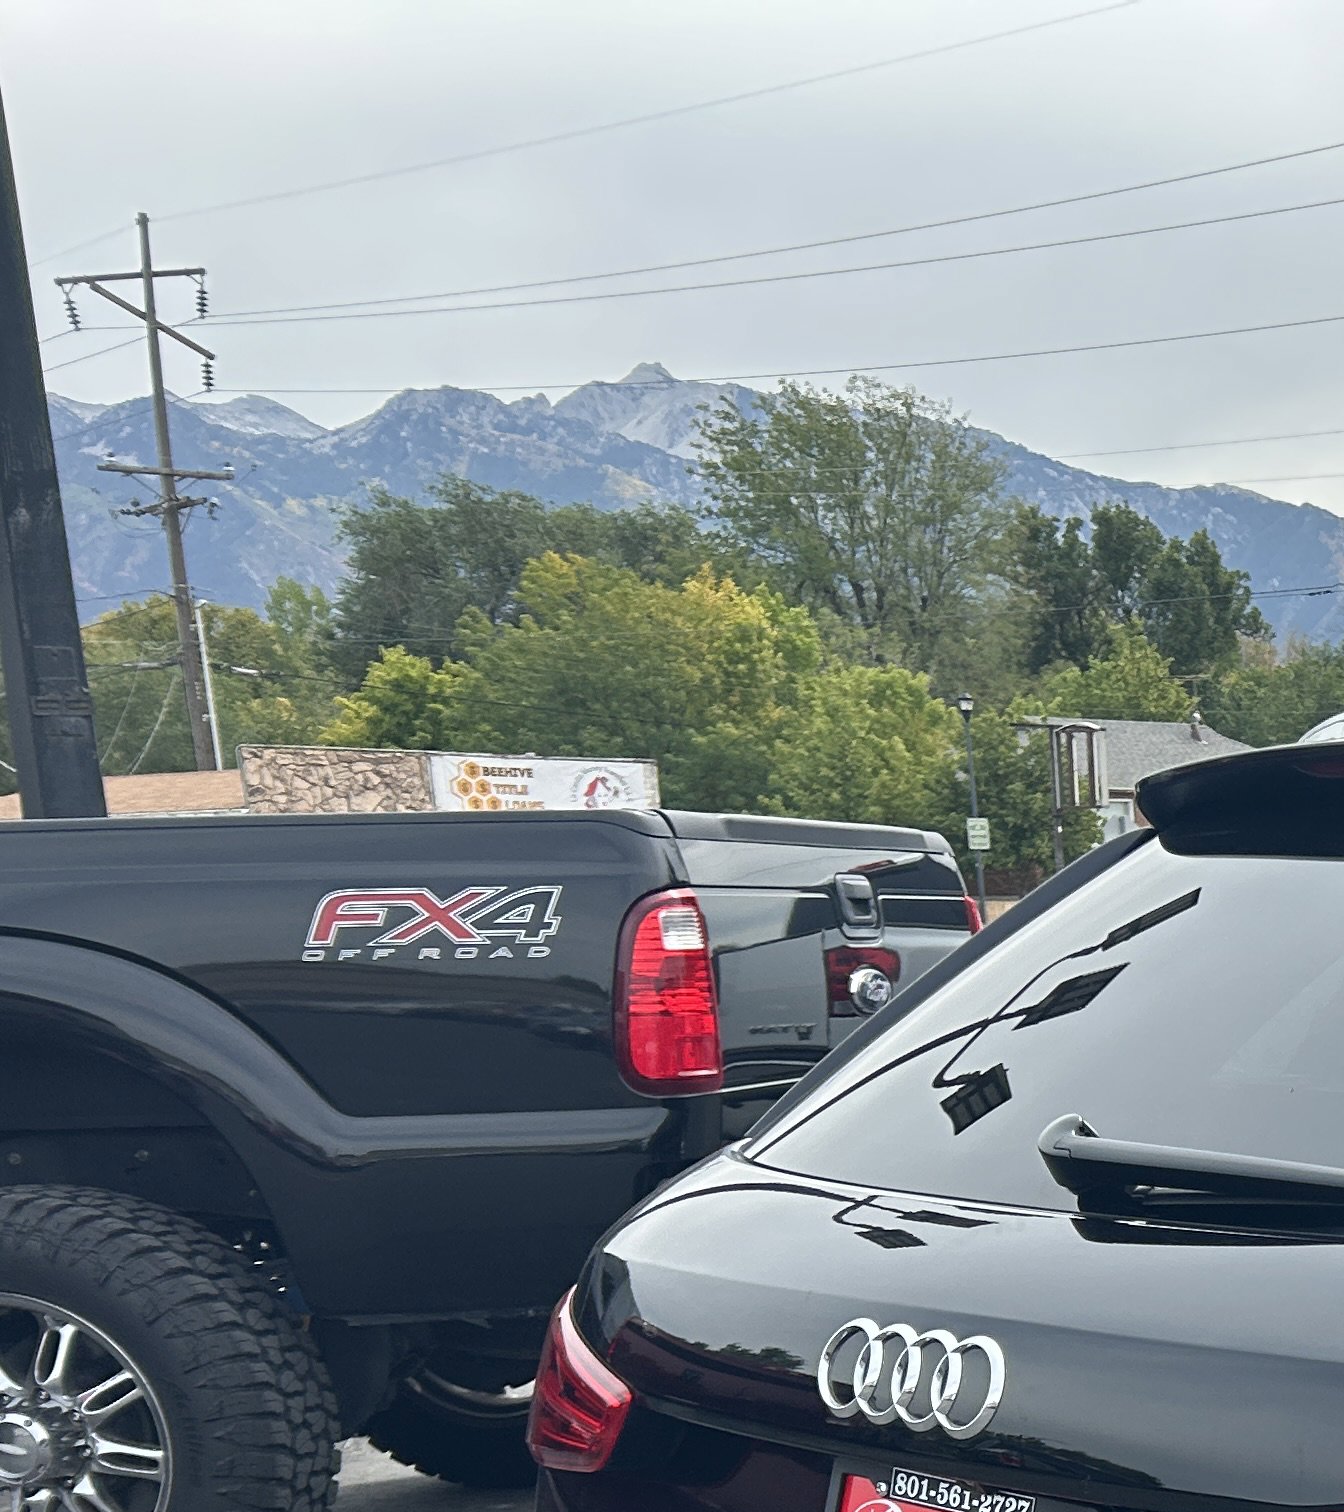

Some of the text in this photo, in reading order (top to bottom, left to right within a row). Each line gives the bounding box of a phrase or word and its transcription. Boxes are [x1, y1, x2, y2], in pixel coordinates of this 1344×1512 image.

[482, 767, 534, 778] BEEHIVE
[304, 886, 563, 946] FX4
[302, 946, 551, 962] OFF ROAD
